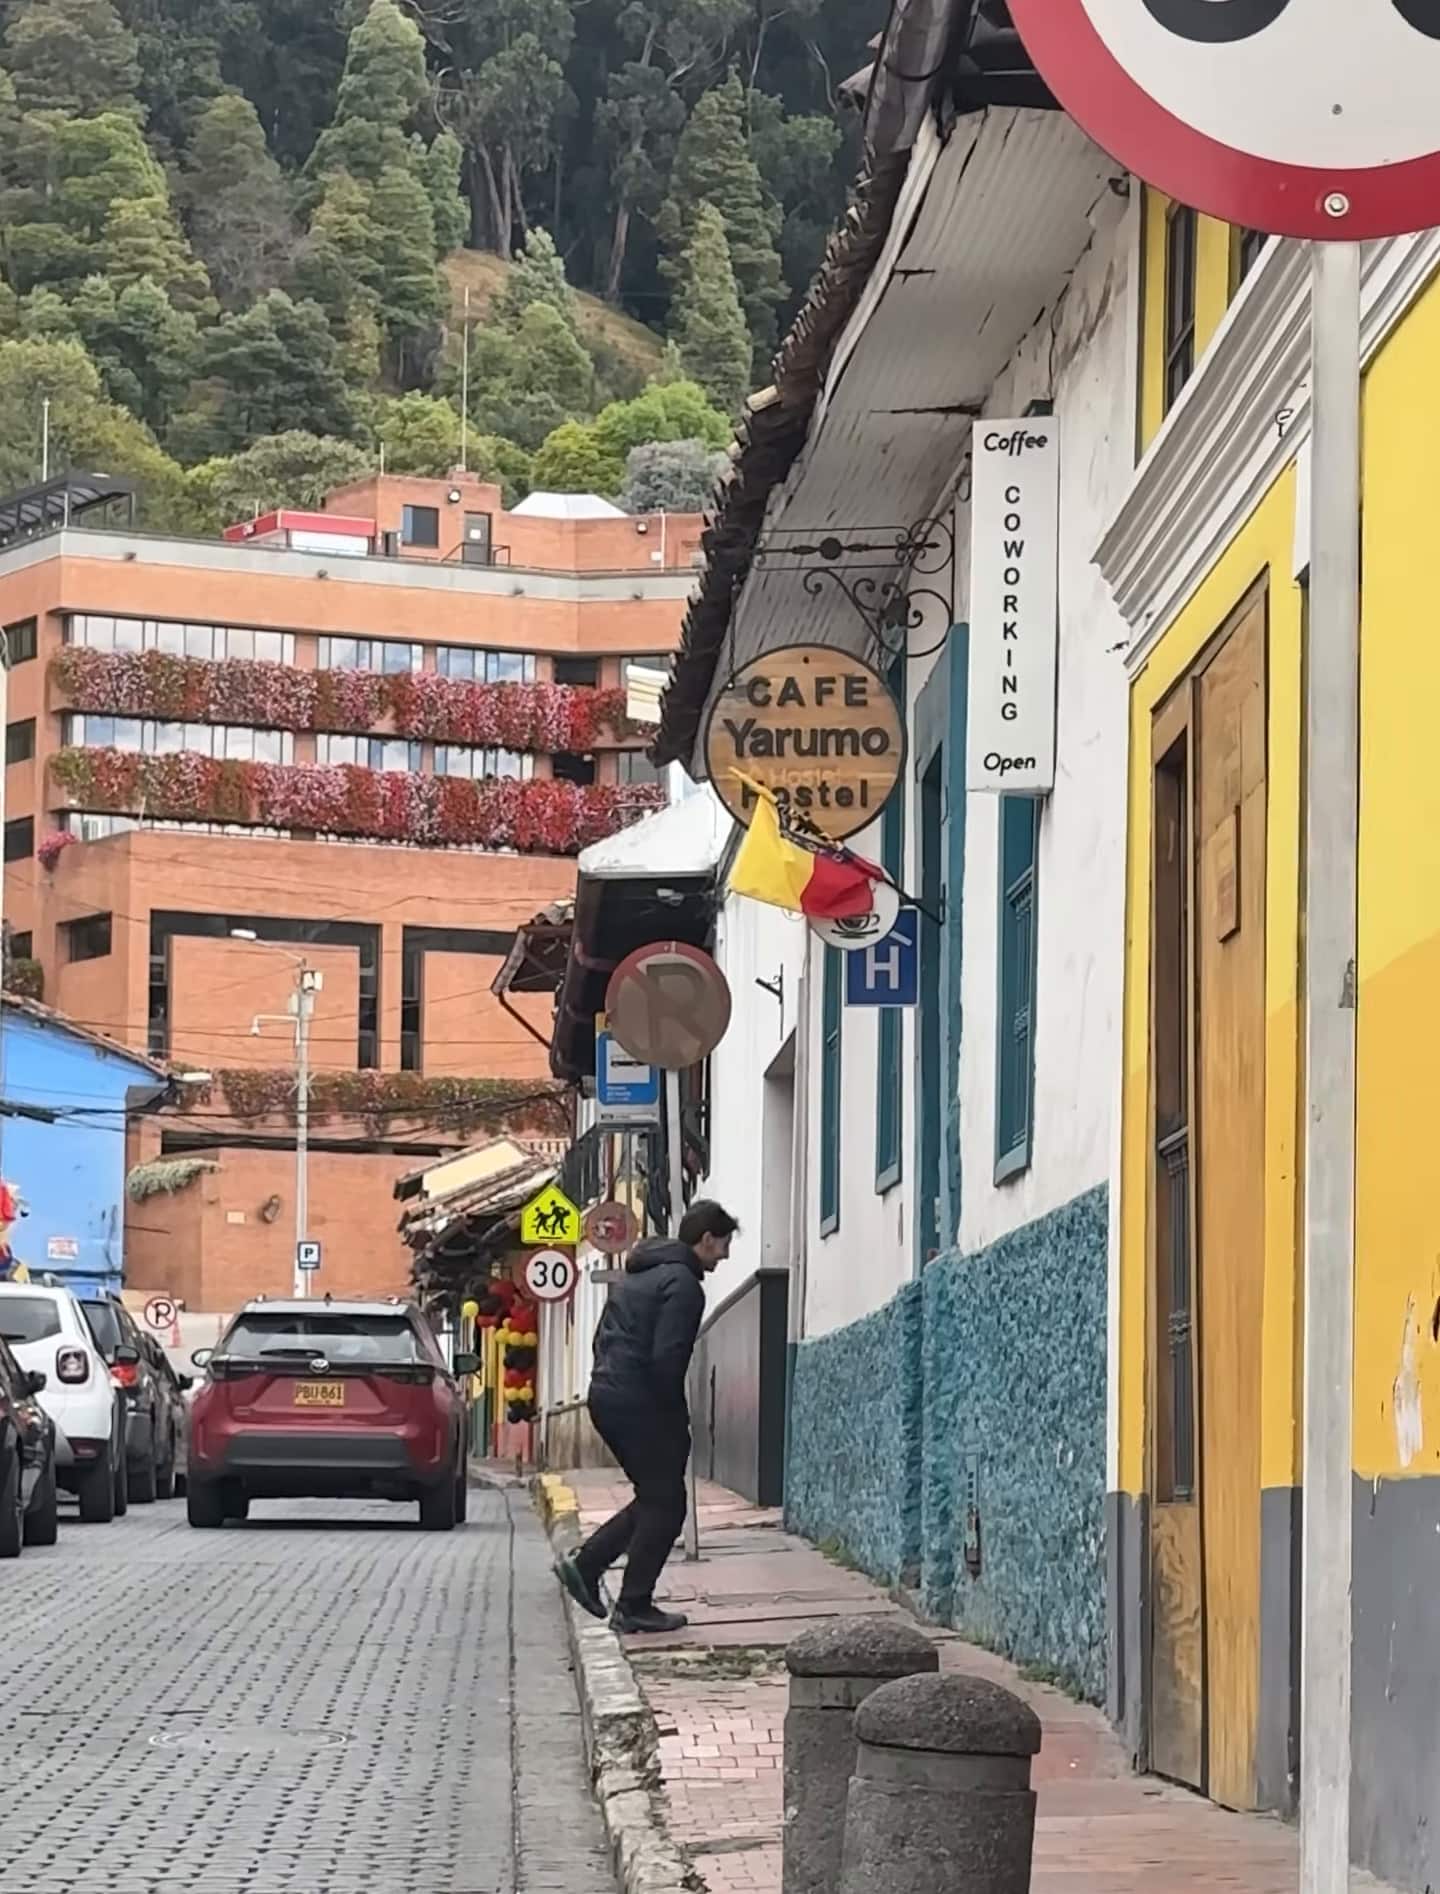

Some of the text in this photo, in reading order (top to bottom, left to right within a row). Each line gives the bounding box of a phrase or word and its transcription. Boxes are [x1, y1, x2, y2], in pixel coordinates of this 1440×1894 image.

[984, 430, 1048, 456] Coffee
[1001, 485, 1025, 721] COWORKING
[748, 675, 869, 708] CAFE
[723, 718, 890, 758] Yarumo
[983, 752, 1037, 776] Open
[865, 945, 899, 989] H
[304, 1247, 314, 1259] P
[533, 1261, 568, 1288] 30
